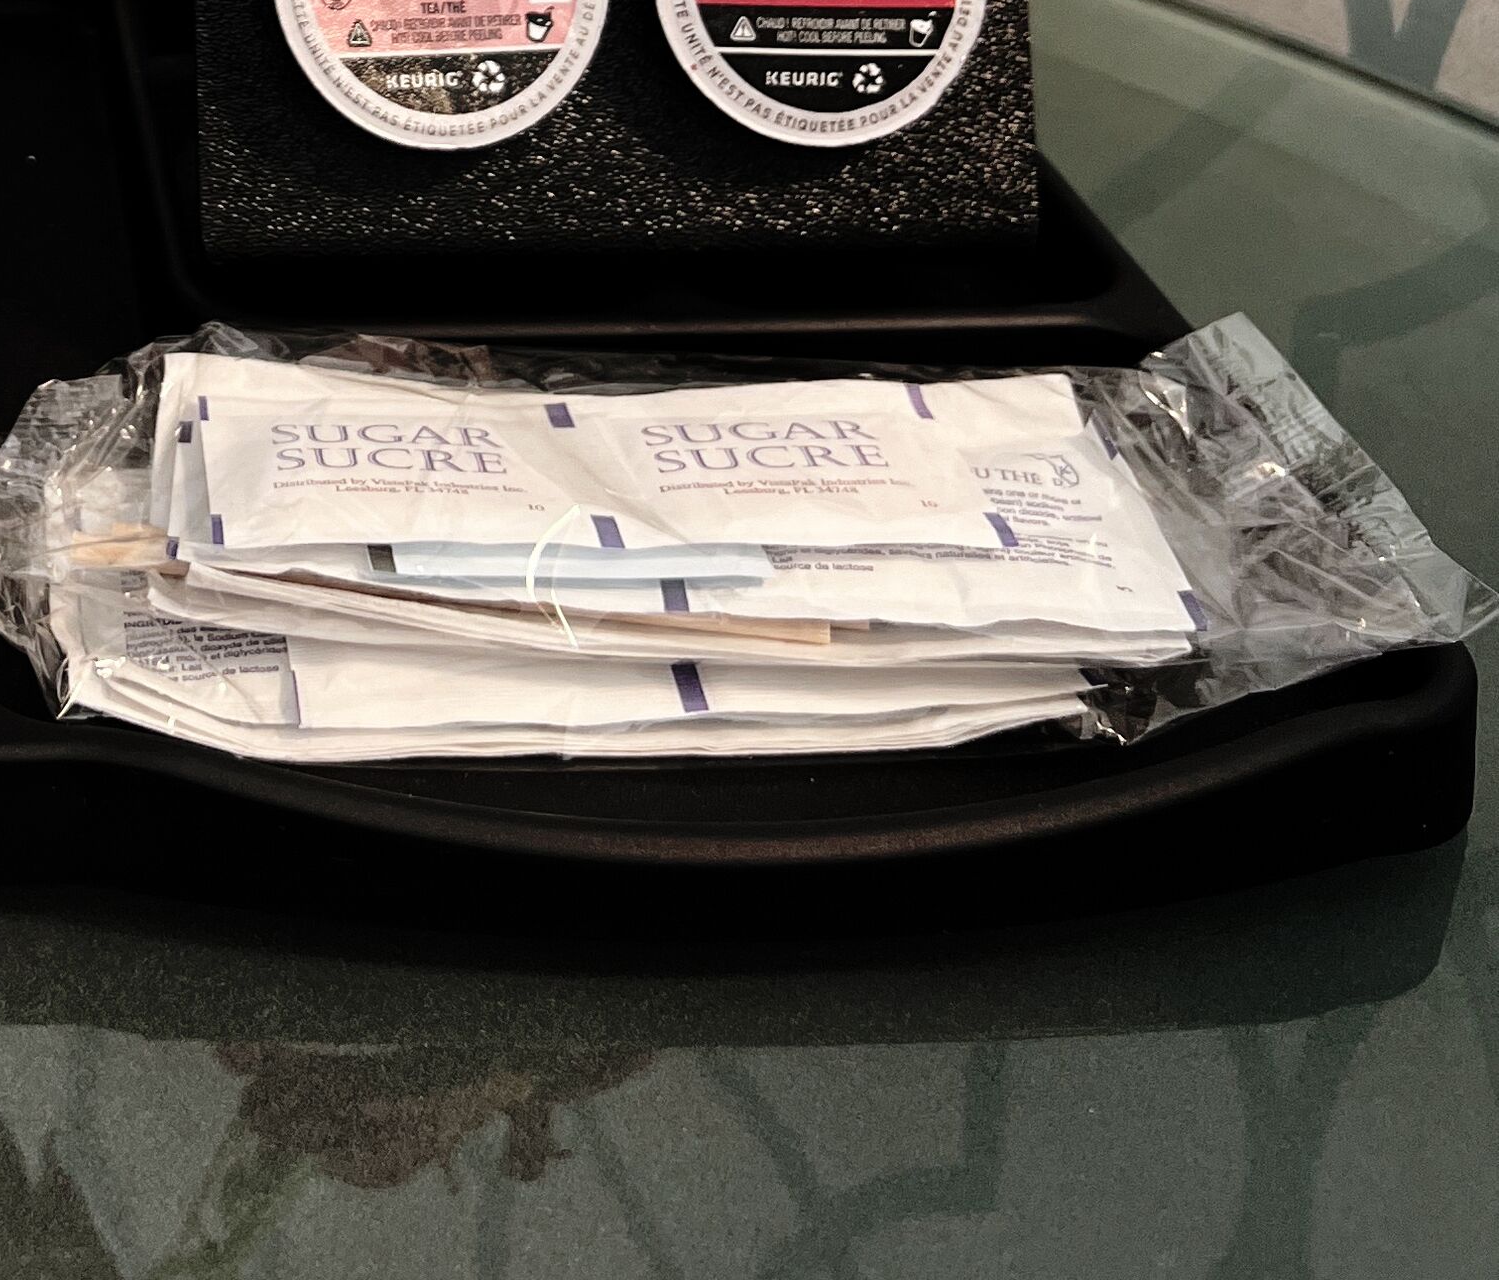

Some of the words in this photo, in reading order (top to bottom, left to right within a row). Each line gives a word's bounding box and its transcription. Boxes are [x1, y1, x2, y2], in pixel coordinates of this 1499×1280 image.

[386, 71, 459, 90] KEURIG
[402, 116, 485, 137] ÉTIQUETÉE
[489, 103, 528, 129] POUR
[528, 89, 546, 107] LA
[545, 48, 580, 91] VENTE
[574, 26, 590, 46] AU
[680, 22, 712, 66] UNITÉ
[744, 99, 771, 119] PAS
[773, 113, 856, 134] ÉTIQUETÉE
[860, 102, 898, 127] POUR
[899, 91, 917, 107] LA
[917, 52, 952, 93] VENTE
[947, 30, 963, 50] AU
[765, 71, 842, 86] KEURIG
[271, 424, 503, 448] SUGAR
[641, 420, 878, 446] SUGAR
[276, 447, 508, 474] SUCRE
[654, 444, 889, 473] SUCRE
[273, 477, 347, 489] Distributed
[350, 477, 366, 486] by
[659, 480, 735, 493] Distributed
[738, 479, 754, 488] by
[239, 664, 280, 673] lactose
